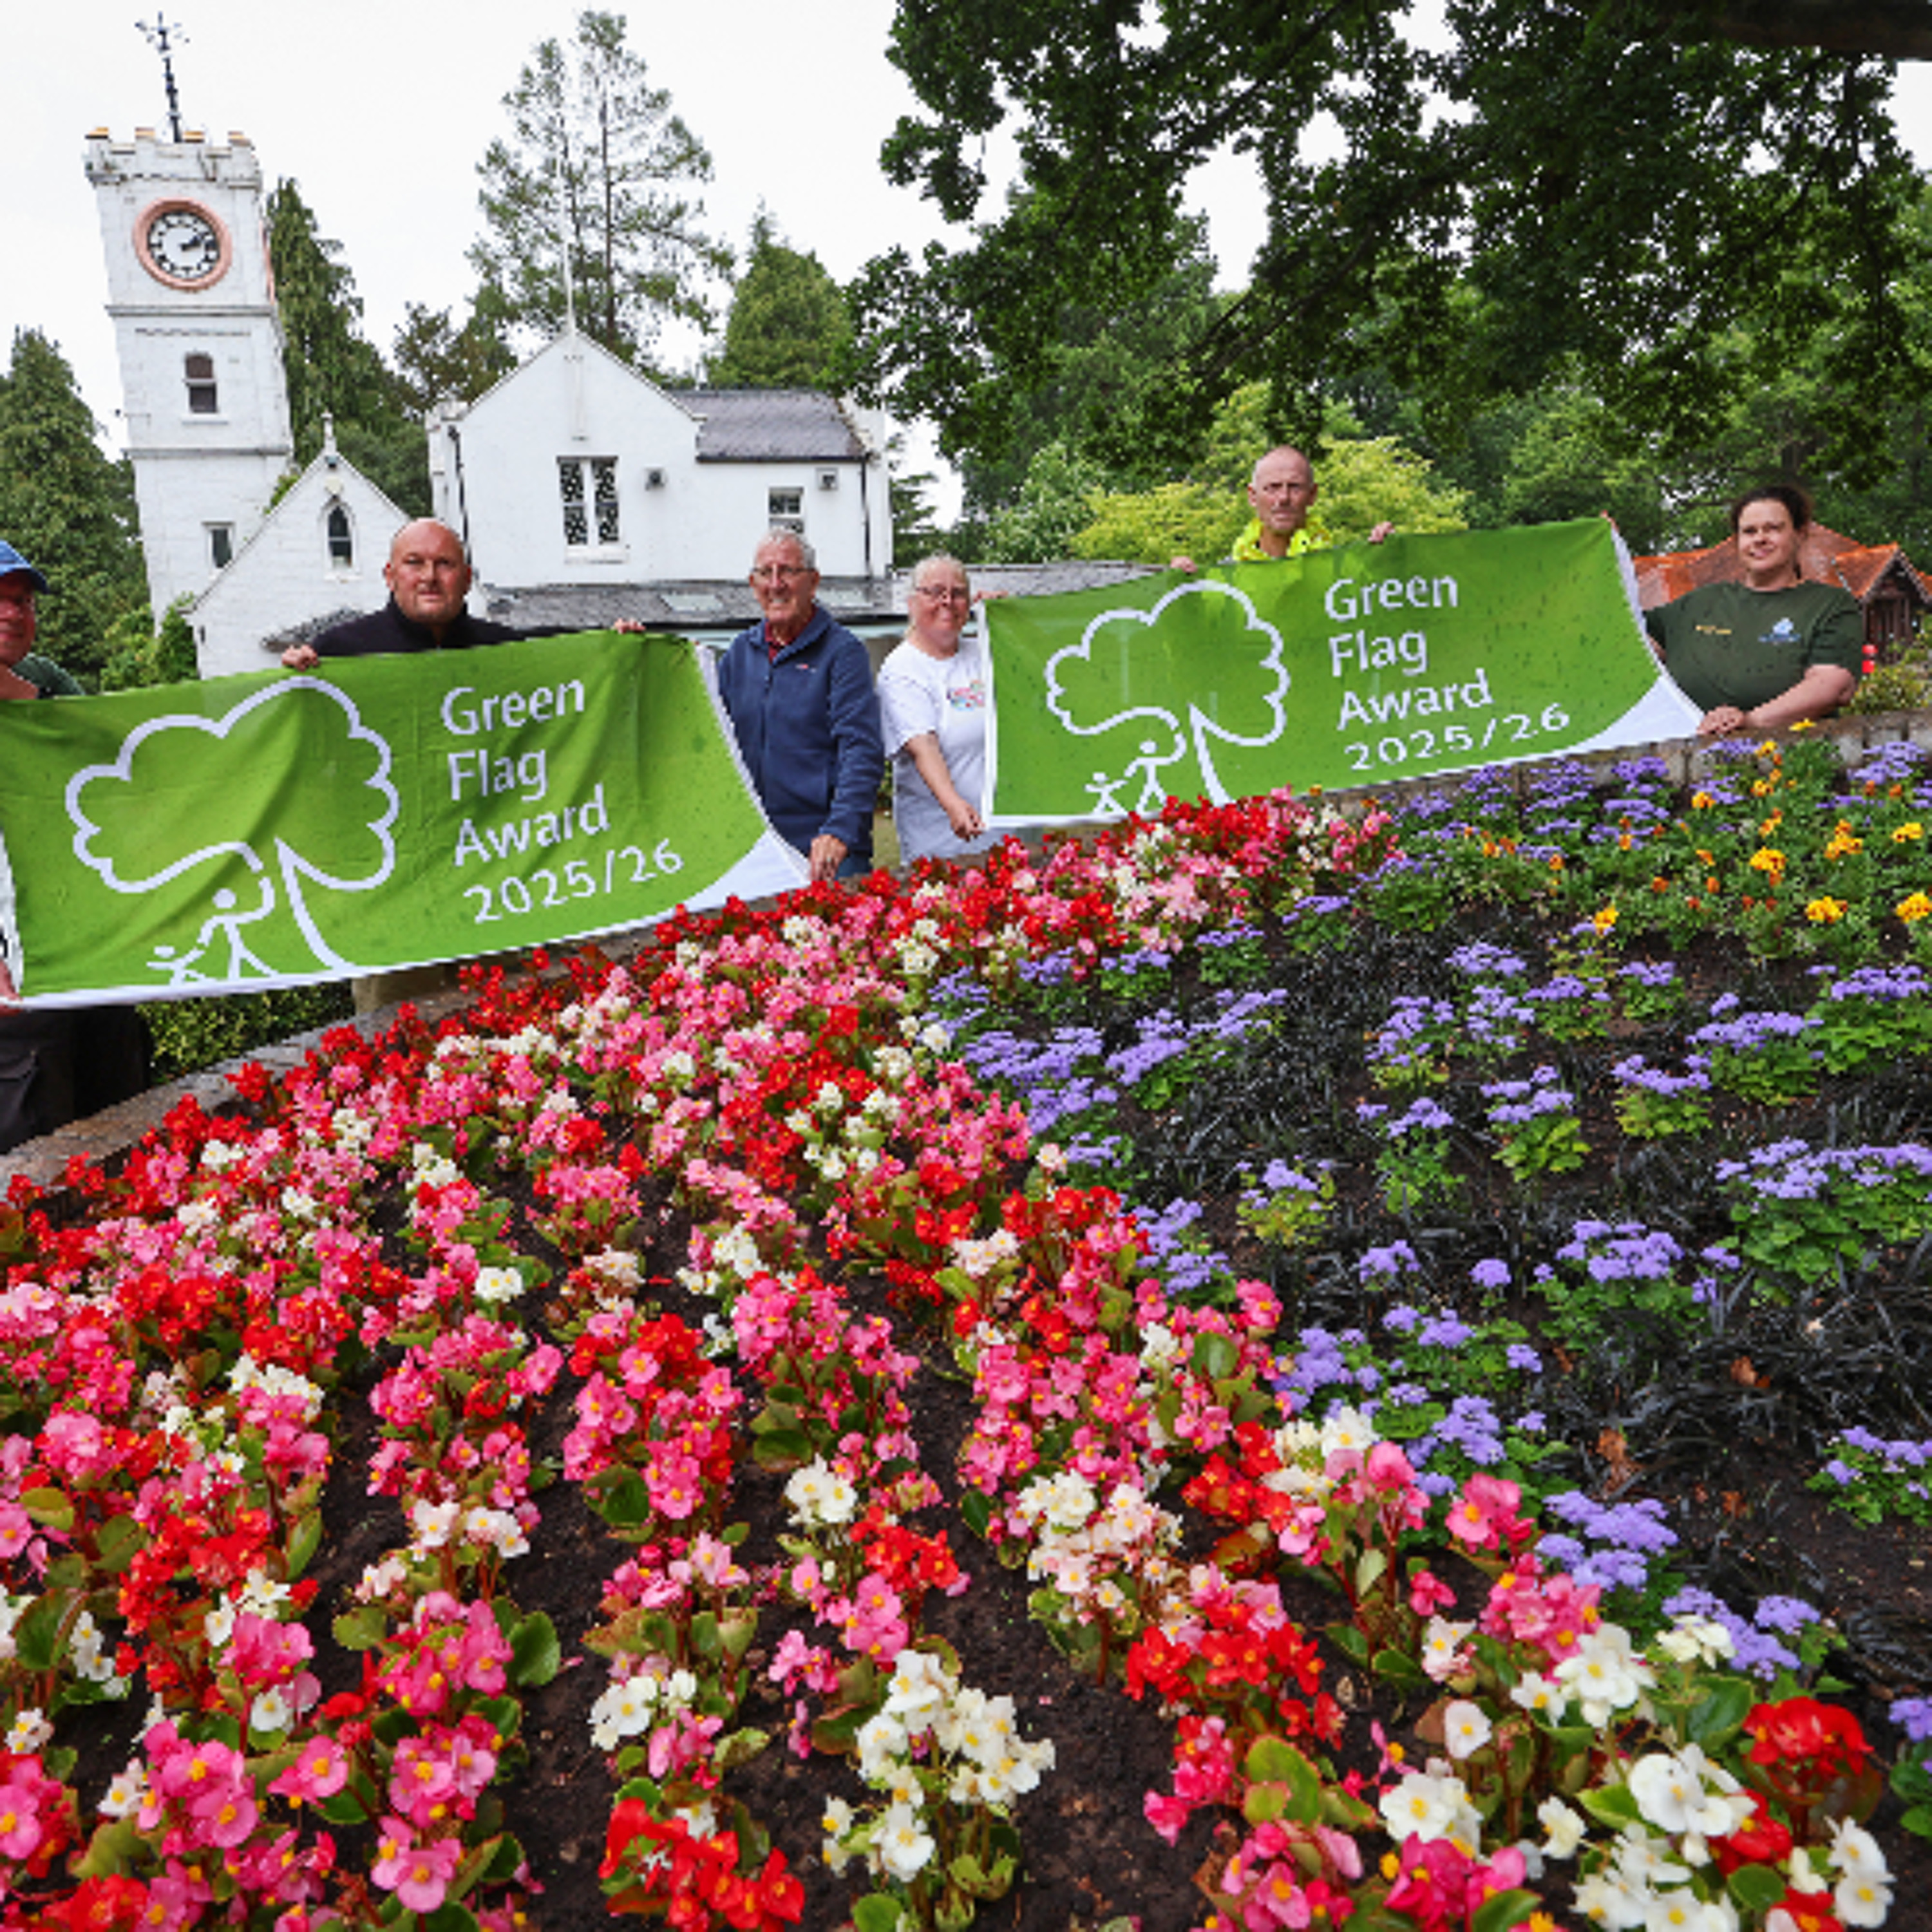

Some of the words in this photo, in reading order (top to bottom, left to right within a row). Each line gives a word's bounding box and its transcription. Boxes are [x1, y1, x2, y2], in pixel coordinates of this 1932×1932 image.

[1325, 575, 1458, 621] Green
[1329, 630, 1428, 677] Flag
[441, 679, 584, 735] Green
[1338, 668, 1493, 730] Award
[1345, 703, 1569, 770] 2025/26
[448, 749, 547, 801] Flag
[455, 783, 609, 866] Award
[463, 839, 683, 923] 2025/26
